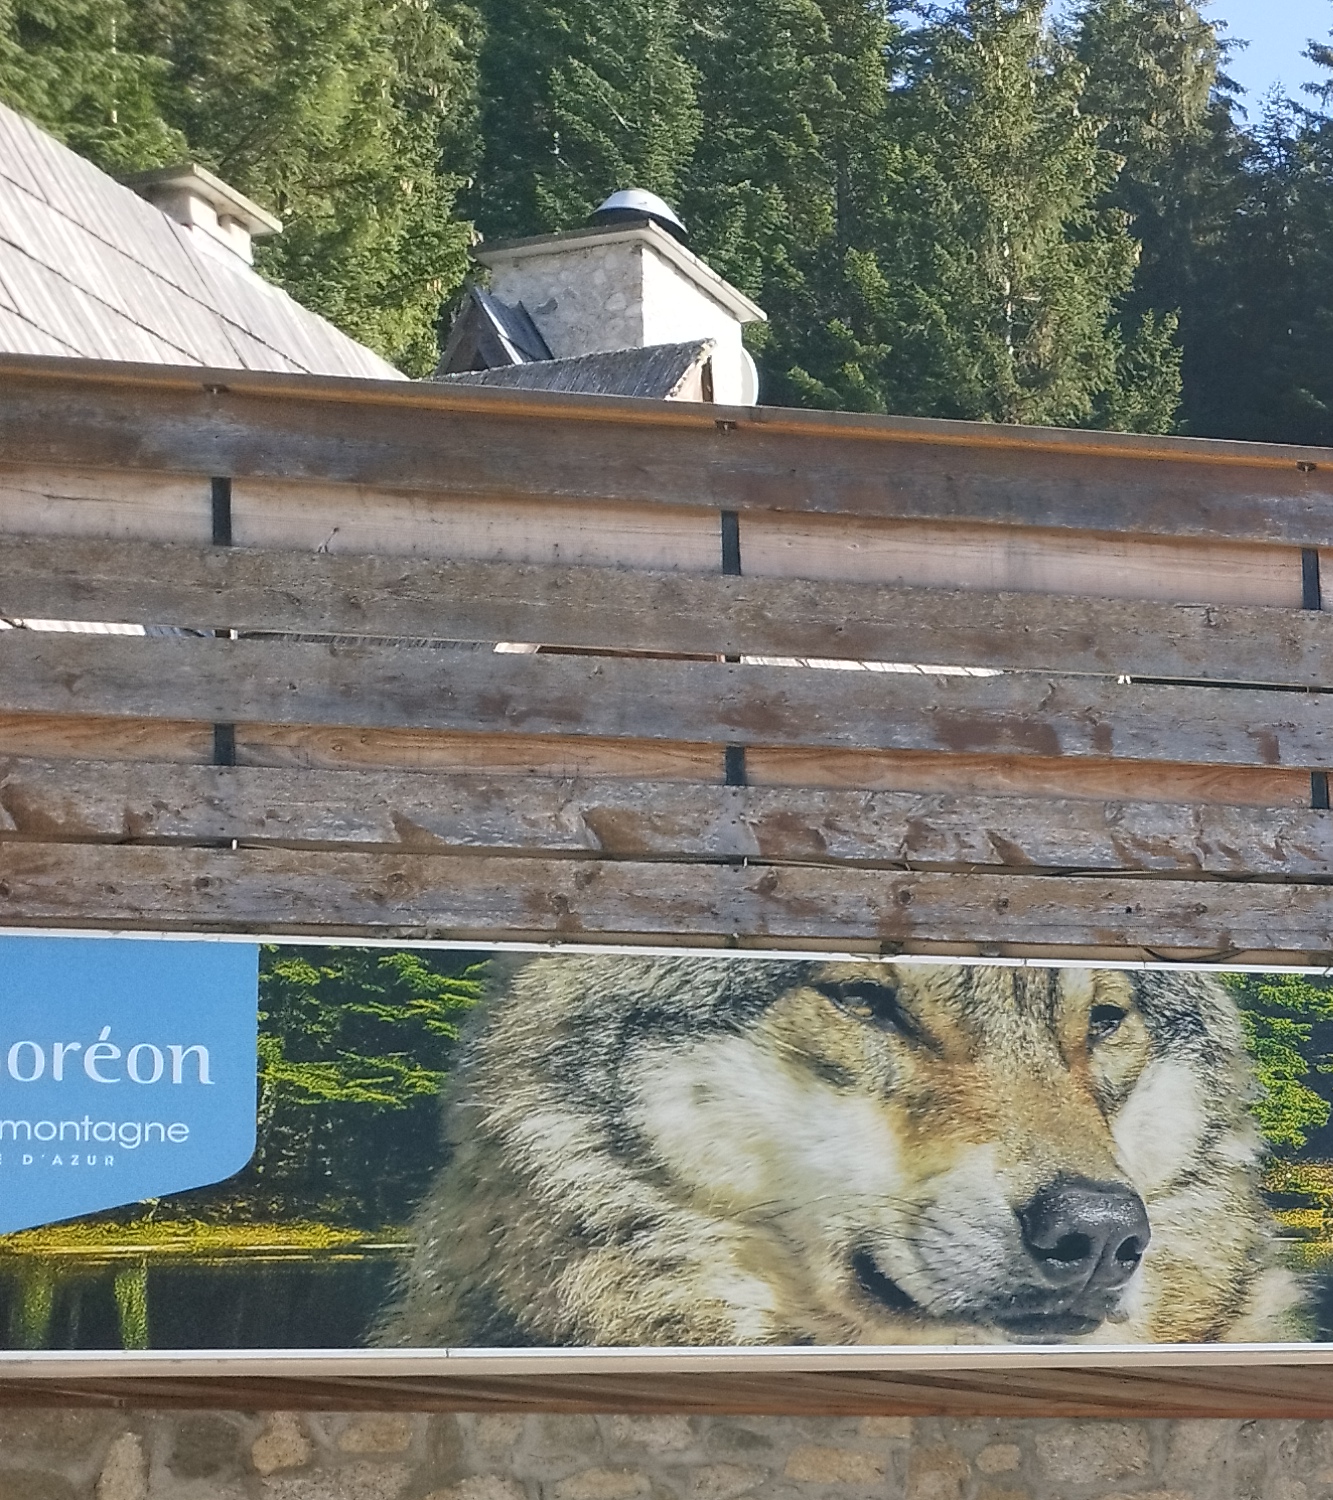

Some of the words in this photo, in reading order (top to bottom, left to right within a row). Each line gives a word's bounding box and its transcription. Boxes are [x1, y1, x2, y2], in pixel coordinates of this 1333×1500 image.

[0, 1025, 215, 1084] oréon
[0, 1115, 189, 1149] montagne
[22, 1154, 114, 1166] D'AZUR
